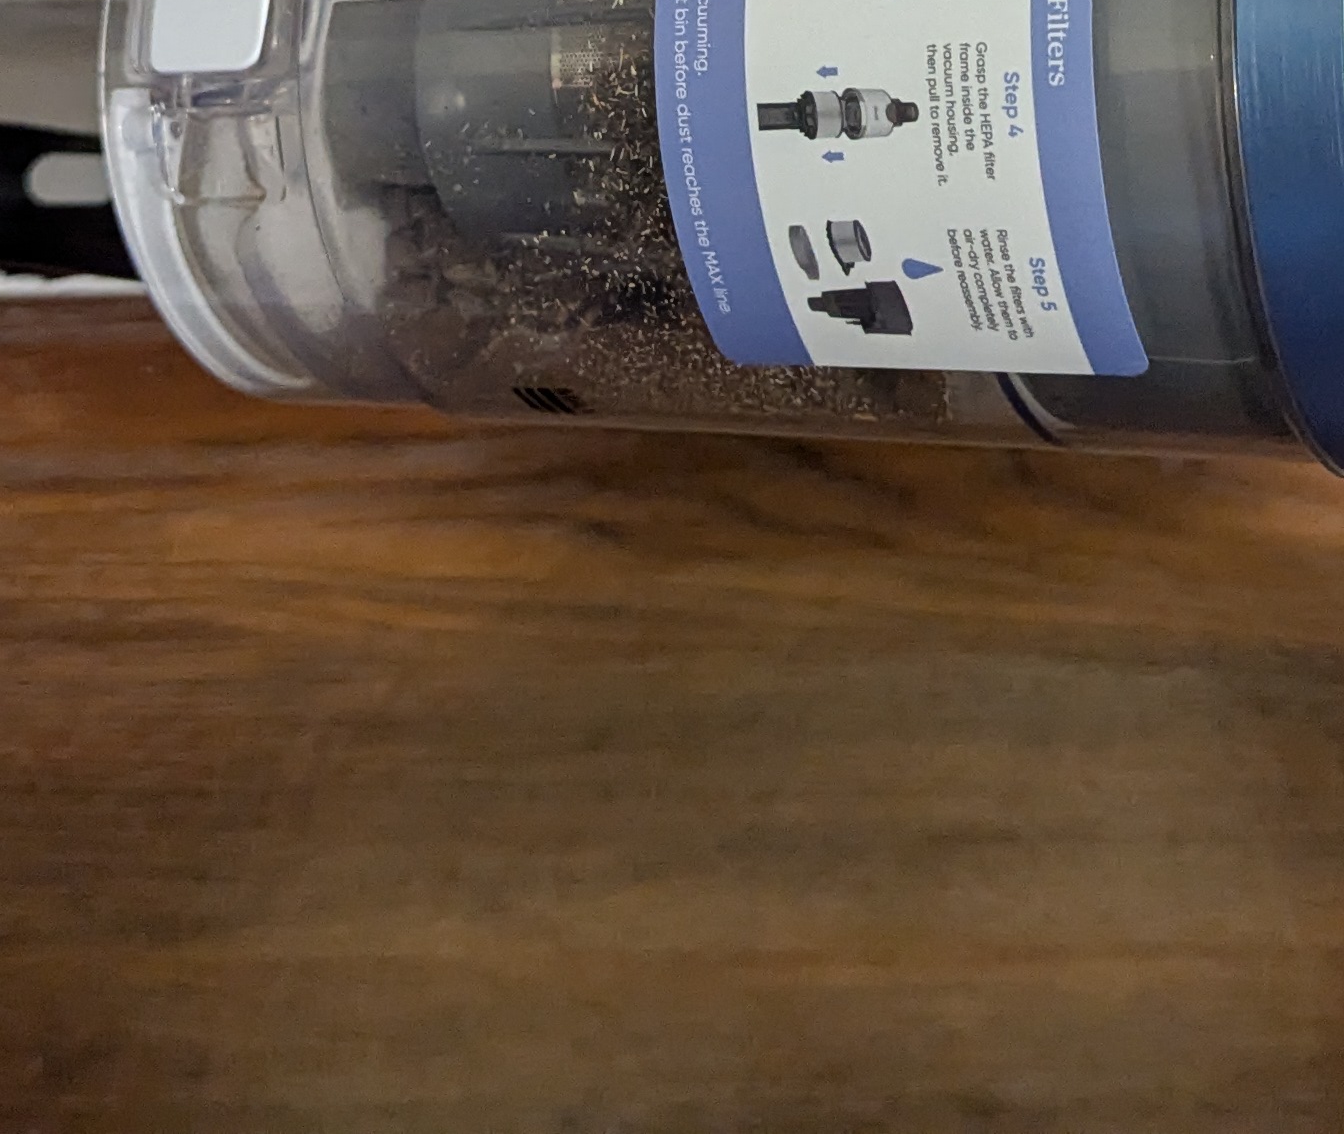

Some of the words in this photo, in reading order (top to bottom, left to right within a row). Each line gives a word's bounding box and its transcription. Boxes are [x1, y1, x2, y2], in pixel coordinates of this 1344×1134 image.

[674, 8, 689, 36] bin
[674, 40, 690, 99] before
[926, 44, 938, 74] then
[943, 43, 954, 96] vacuum
[959, 43, 971, 82] frame
[975, 42, 988, 84] Grasp
[926, 78, 940, 102] pull
[961, 86, 974, 125] inside
[977, 88, 989, 110] the
[1001, 72, 1020, 119] Step
[677, 104, 693, 142] dust
[929, 106, 940, 119] to
[931, 122, 946, 171] remove
[965, 128, 976, 151] the
[979, 114, 994, 148] HEPA
[1008, 124, 1024, 138] 4
[681, 148, 705, 216] reaches
[937, 174, 948, 186] it.
[983, 152, 997, 180] filter
[694, 220, 710, 246] the
[947, 228, 963, 268] before
[996, 229, 1011, 261] Rinse
[701, 251, 725, 284] MAX
[963, 229, 980, 270] air-dry
[973, 272, 1000, 331] completely
[980, 228, 995, 265] water.
[988, 268, 1004, 298] Allow
[998, 301, 1014, 327] them
[1008, 330, 1018, 340] to
[1004, 264, 1015, 283] the
[1009, 286, 1025, 314] filters
[1029, 257, 1049, 297] Step
[1040, 301, 1058, 312] 5
[1019, 317, 1035, 338] with
